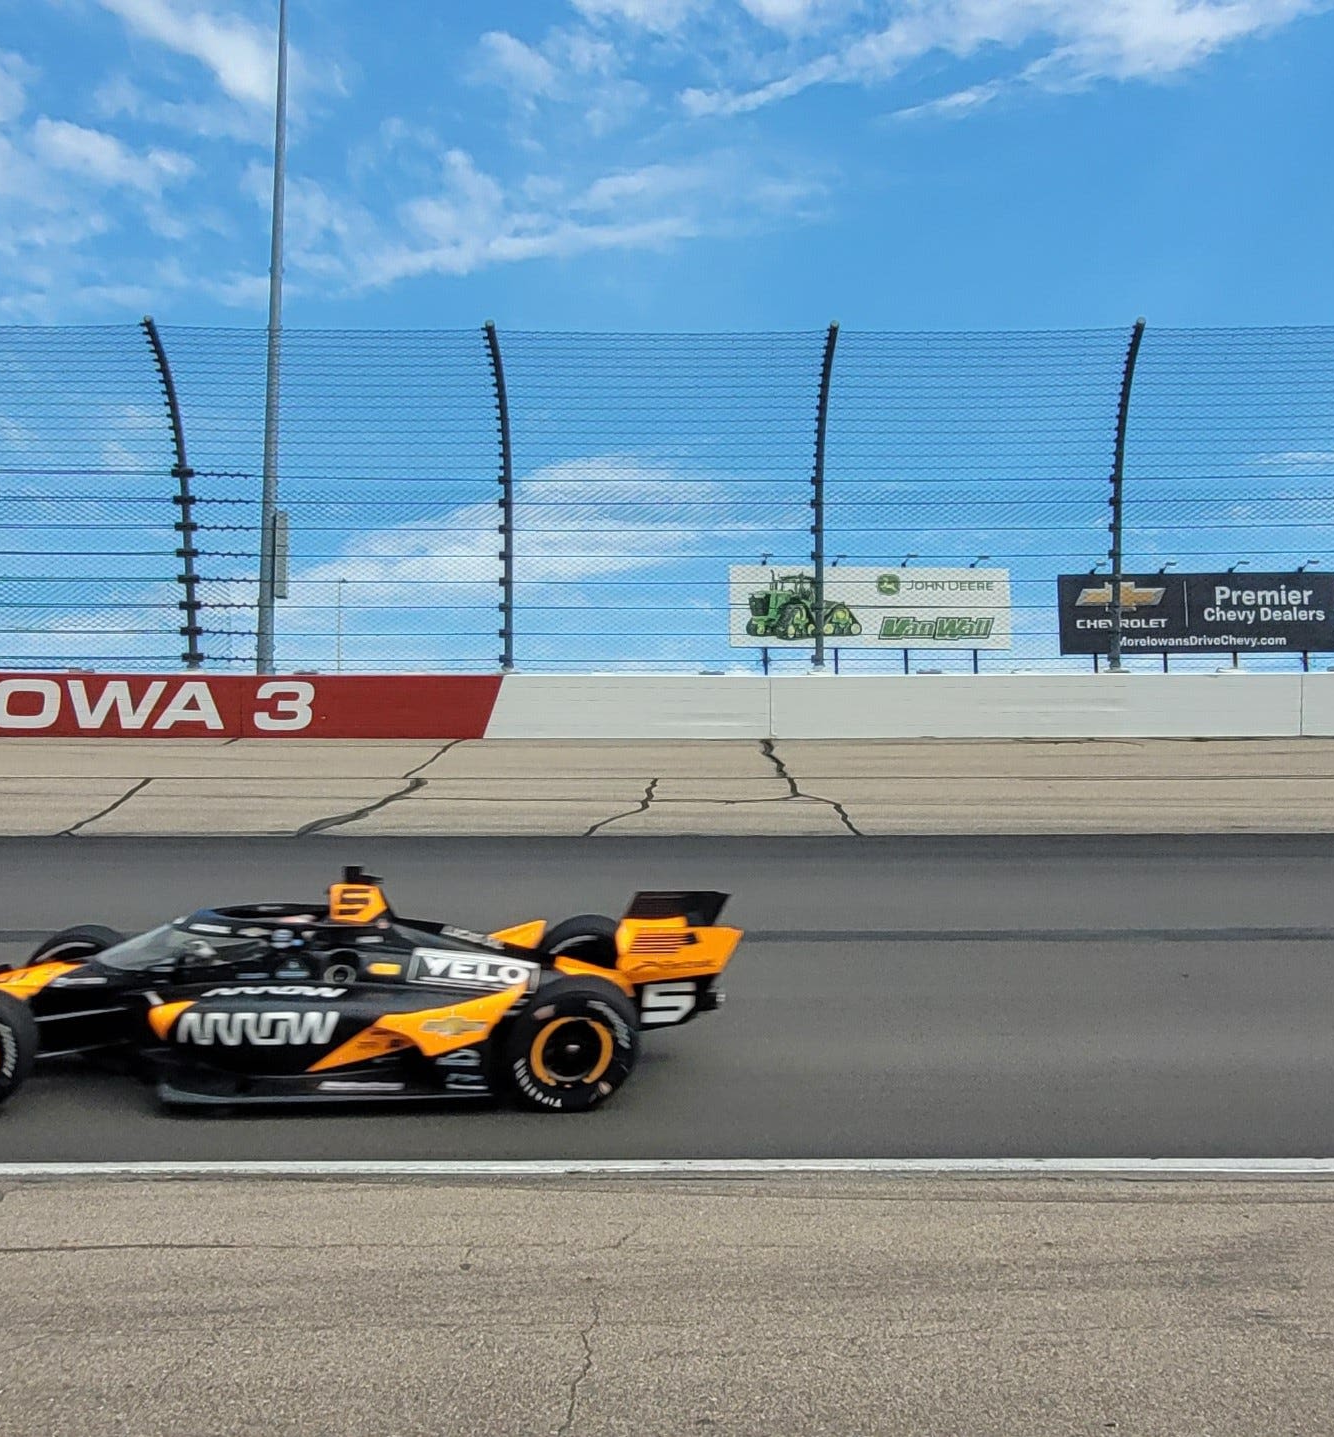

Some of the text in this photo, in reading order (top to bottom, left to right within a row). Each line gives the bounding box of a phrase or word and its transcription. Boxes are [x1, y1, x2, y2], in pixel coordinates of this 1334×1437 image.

[906, 579, 994, 591] JOHN DEERE
[1214, 584, 1313, 606] Premier
[1203, 606, 1326, 625] Chevy Dealers
[253, 680, 316, 731] 3
[336, 888, 372, 916] 5
[422, 957, 530, 985] VELO
[640, 981, 697, 1024] 5
[176, 1011, 341, 1046] ARROW
